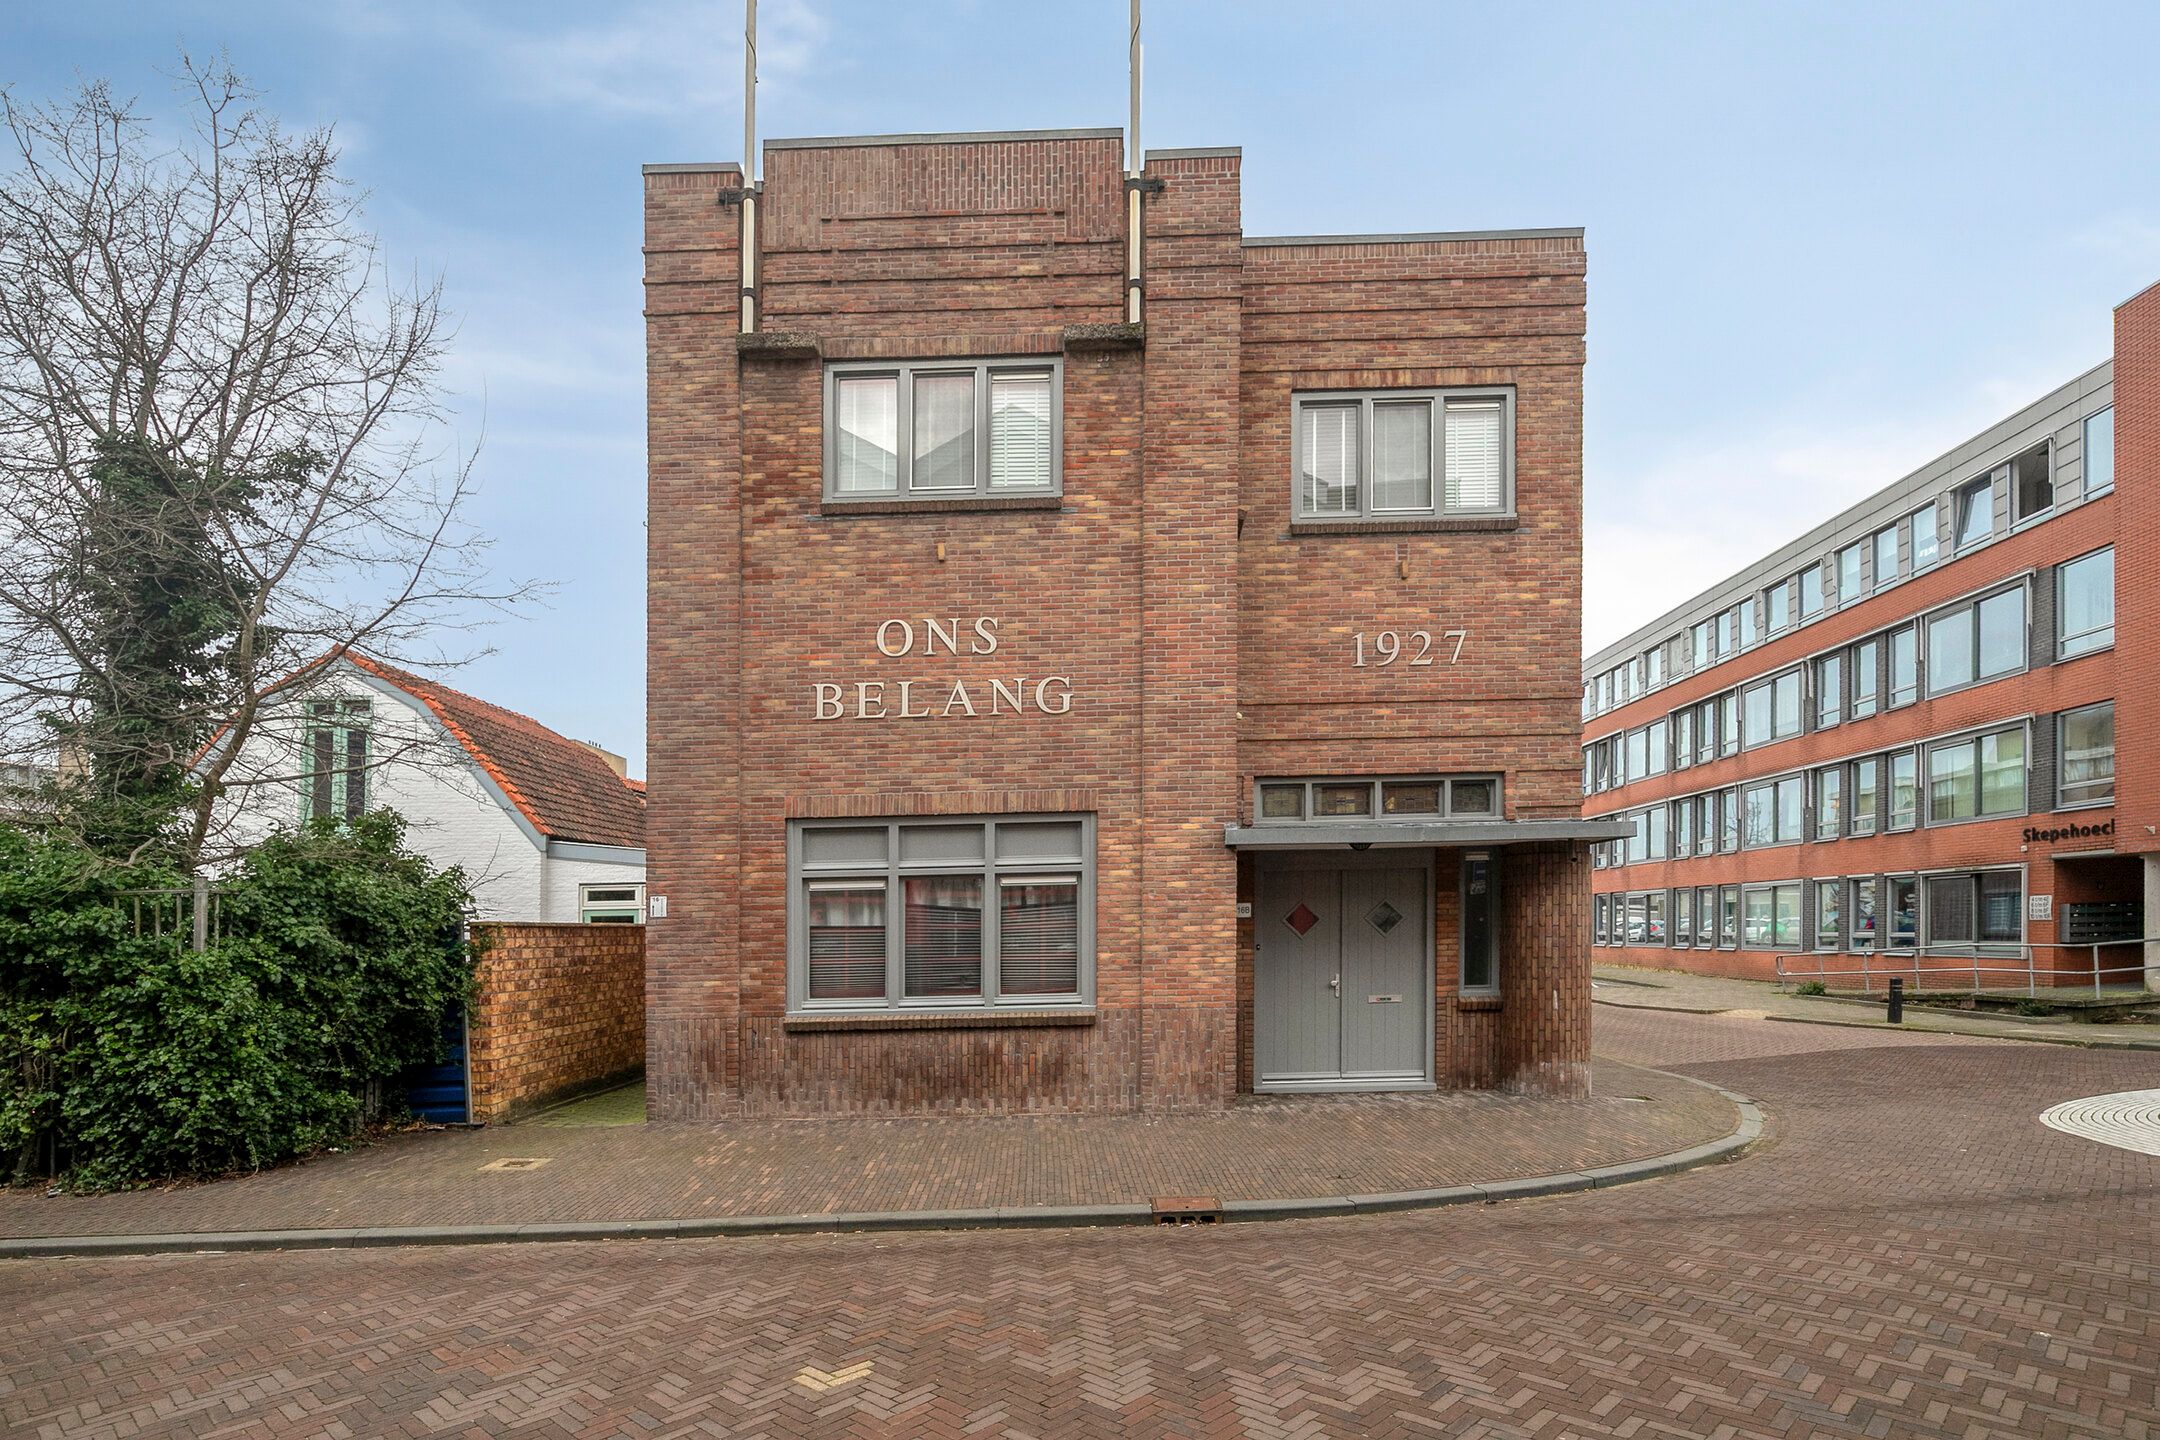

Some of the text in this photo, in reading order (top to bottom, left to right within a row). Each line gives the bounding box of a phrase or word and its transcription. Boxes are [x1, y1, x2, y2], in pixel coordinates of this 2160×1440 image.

[876, 617, 998, 657] ONS
[1352, 630, 1467, 668] 1927
[812, 676, 1075, 720] BELANG
